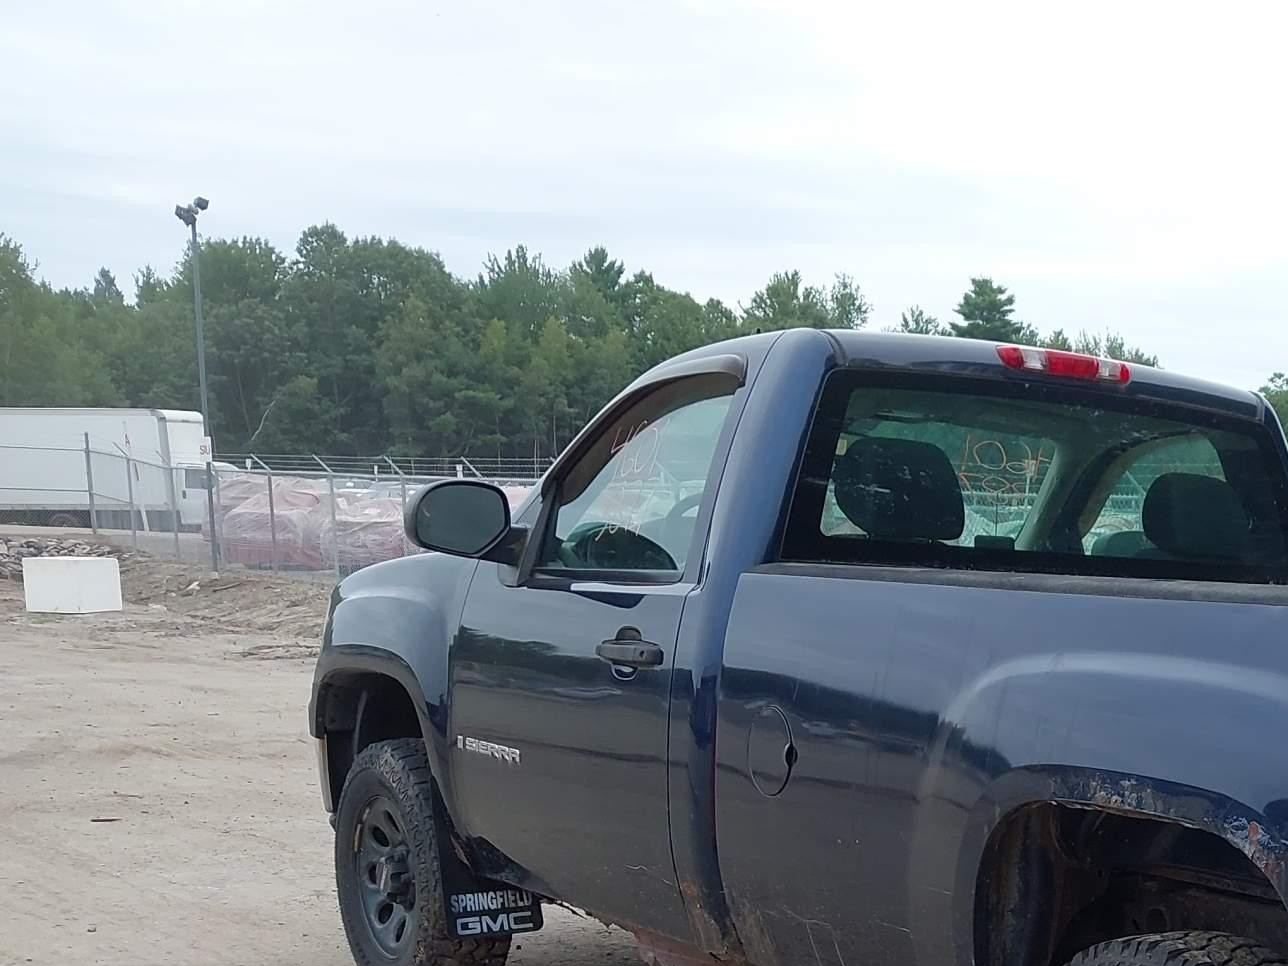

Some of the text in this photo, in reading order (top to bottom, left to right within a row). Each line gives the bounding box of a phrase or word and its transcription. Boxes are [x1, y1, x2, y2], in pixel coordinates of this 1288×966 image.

[465, 737, 520, 763] SIERRA
[450, 890, 533, 912] SPRINGFIELD
[457, 911, 534, 935] GMC
